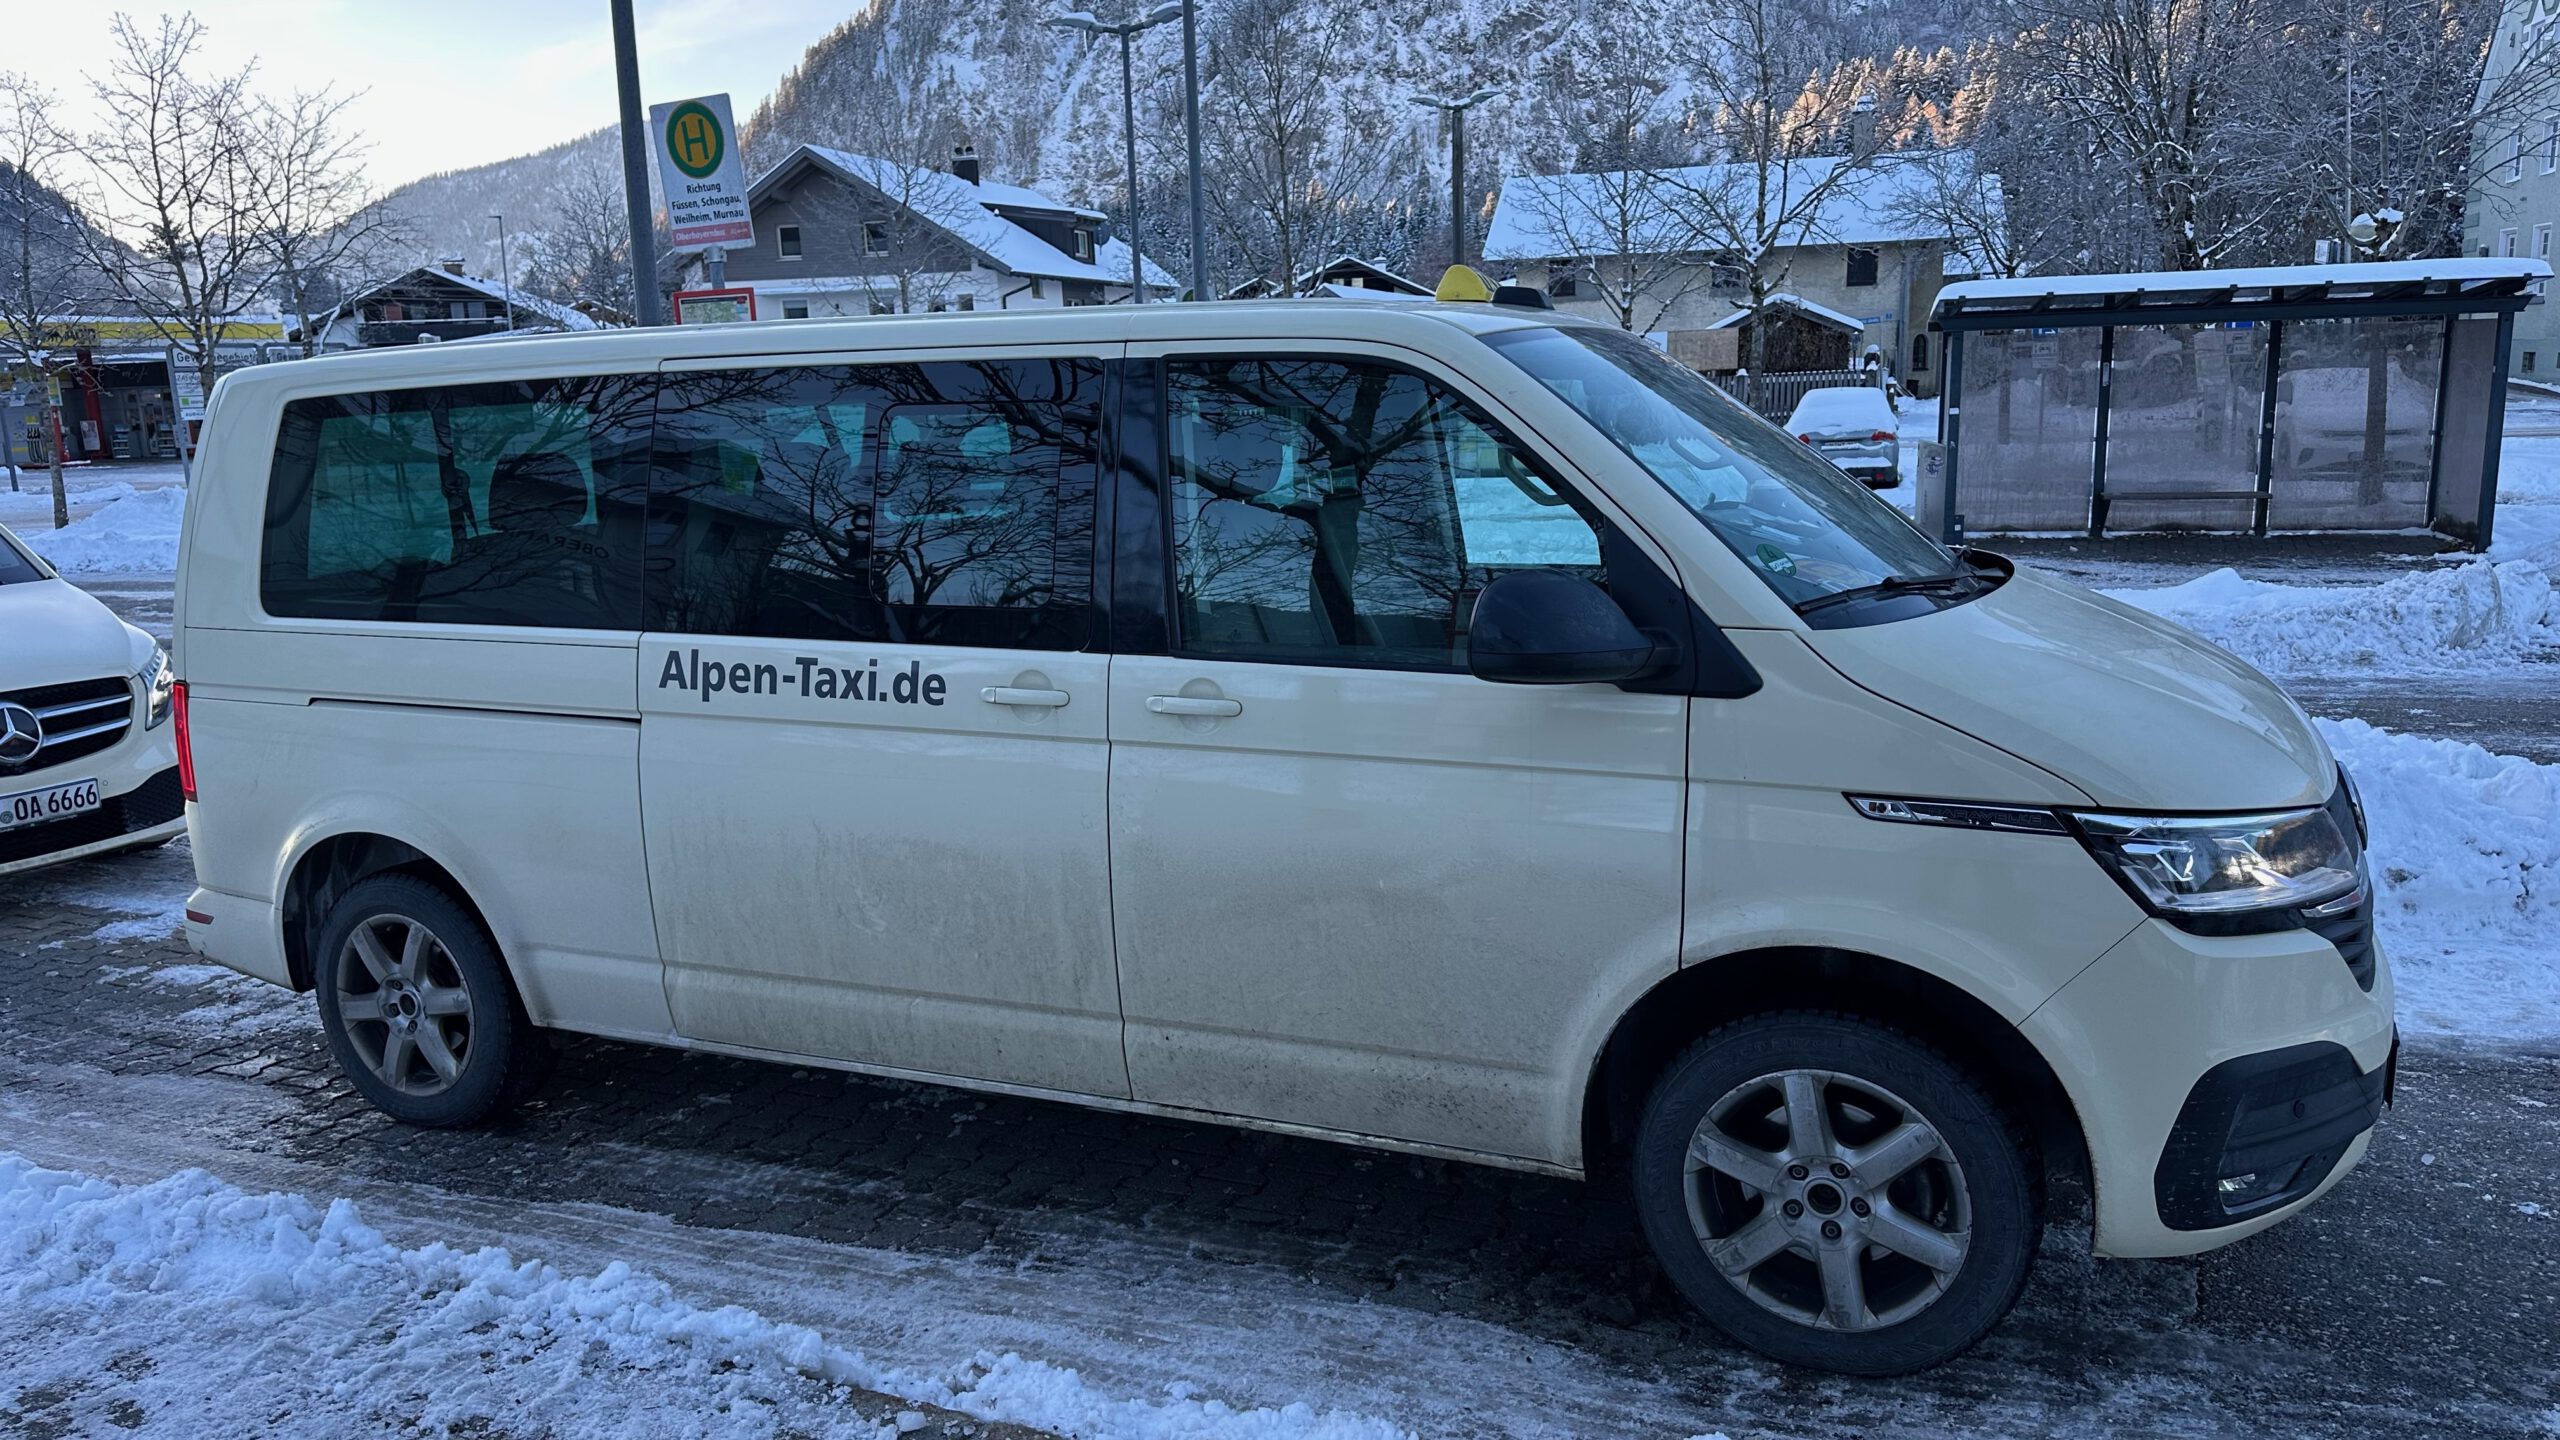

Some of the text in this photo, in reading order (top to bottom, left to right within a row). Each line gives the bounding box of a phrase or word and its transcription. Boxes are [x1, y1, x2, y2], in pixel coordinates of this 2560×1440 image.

[681, 119, 709, 162] H
[686, 182, 721, 194] Richtung
[671, 194, 742, 211] Füssen, Schongau,
[673, 208, 744, 225] Weilheim, Murnau
[658, 648, 947, 706] Alpen-Taxi.de
[48, 784, 97, 813] 6666
